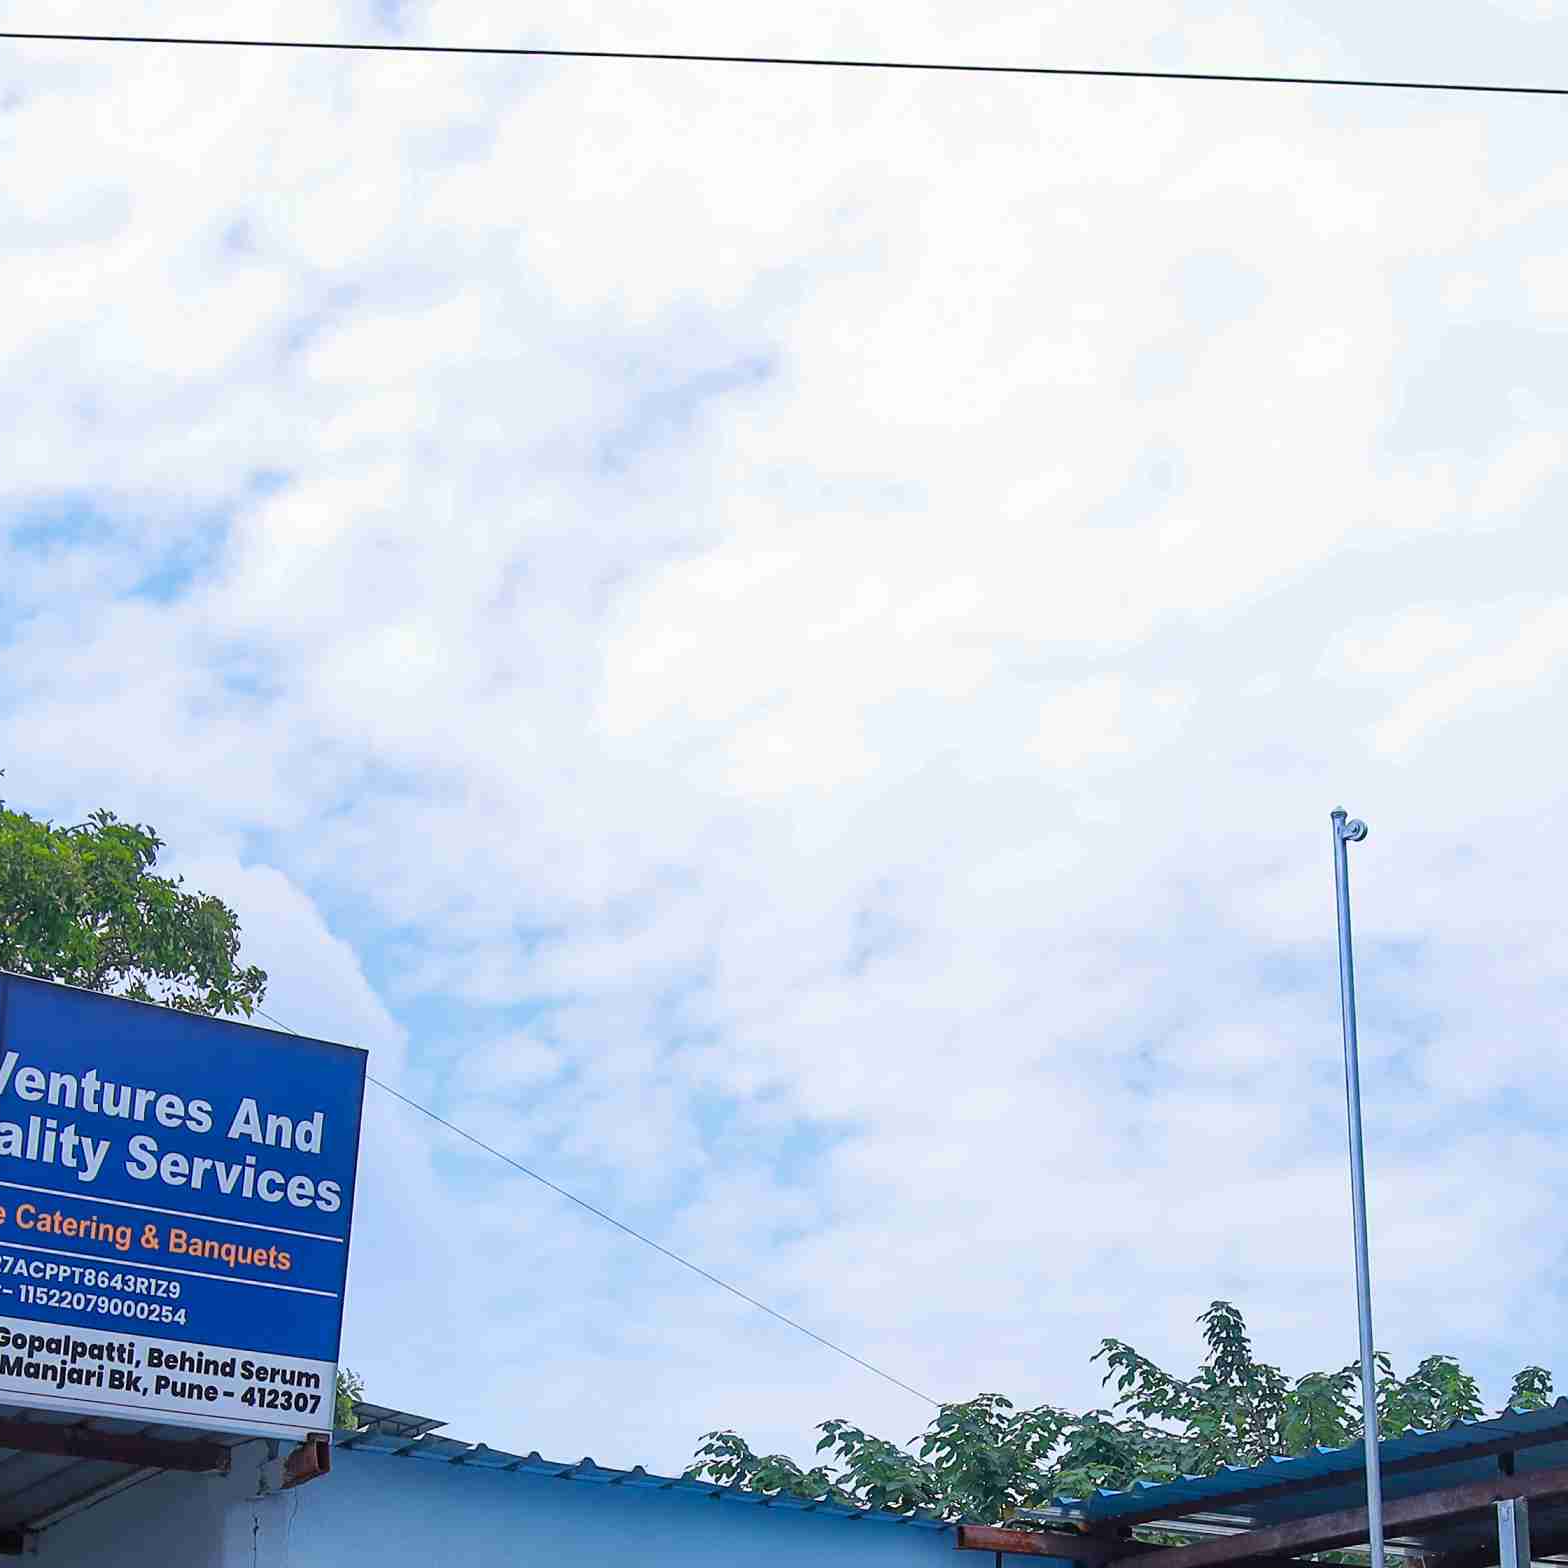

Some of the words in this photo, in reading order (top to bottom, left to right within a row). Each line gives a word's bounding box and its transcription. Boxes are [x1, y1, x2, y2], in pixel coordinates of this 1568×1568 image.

[228, 1097, 324, 1153] And
[126, 1135, 341, 1212] Services
[15, 1204, 132, 1251] Catering
[140, 1224, 159, 1250] &
[168, 1228, 292, 1271] Banquets
[19, 1284, 188, 1325] 11522079000254
[0, 1354, 104, 1389] Manjari
[108, 1369, 149, 1396] Bk,
[155, 1375, 219, 1402] Pune
[241, 1386, 321, 1415] 412307
[147, 1347, 235, 1378] Behind
[240, 1360, 320, 1389] Serum
